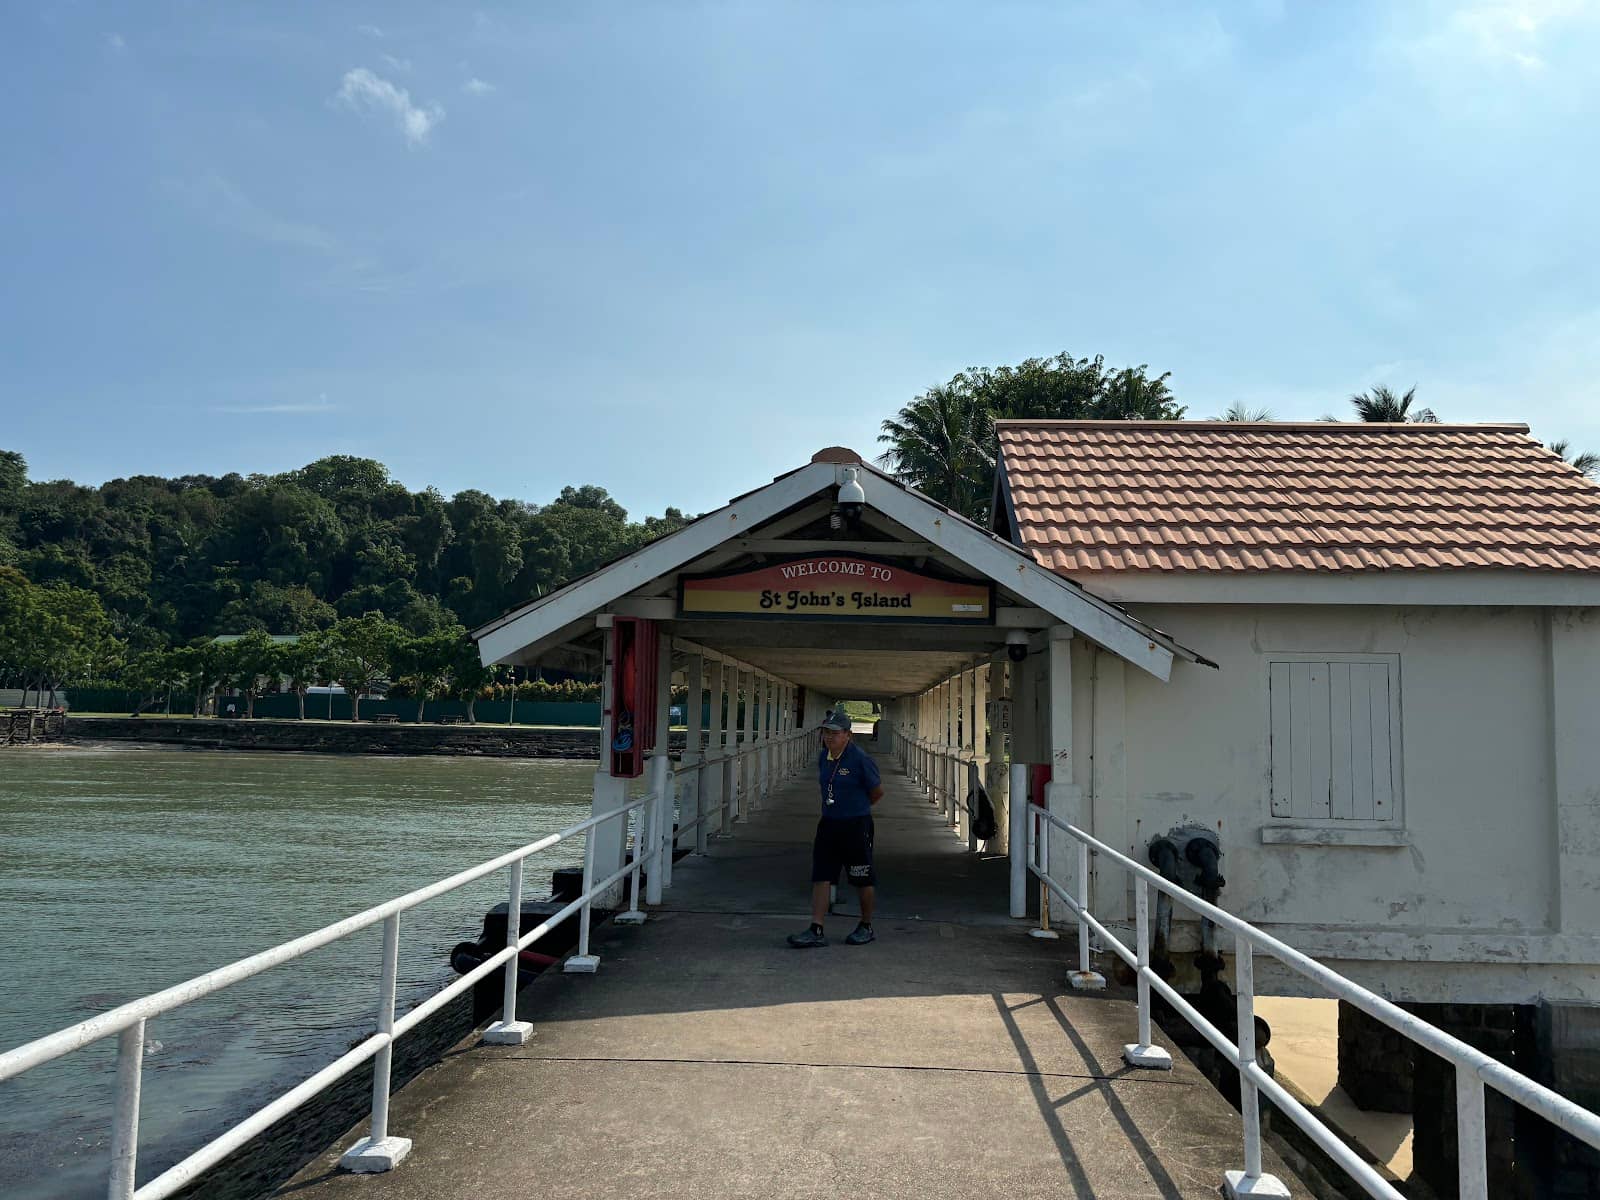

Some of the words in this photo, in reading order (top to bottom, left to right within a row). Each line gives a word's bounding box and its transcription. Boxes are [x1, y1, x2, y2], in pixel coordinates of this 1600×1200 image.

[781, 561, 865, 578] WELCOME
[871, 566, 892, 582] TO
[760, 589, 782, 609] St
[786, 590, 845, 610] John's
[852, 592, 911, 609] Island
